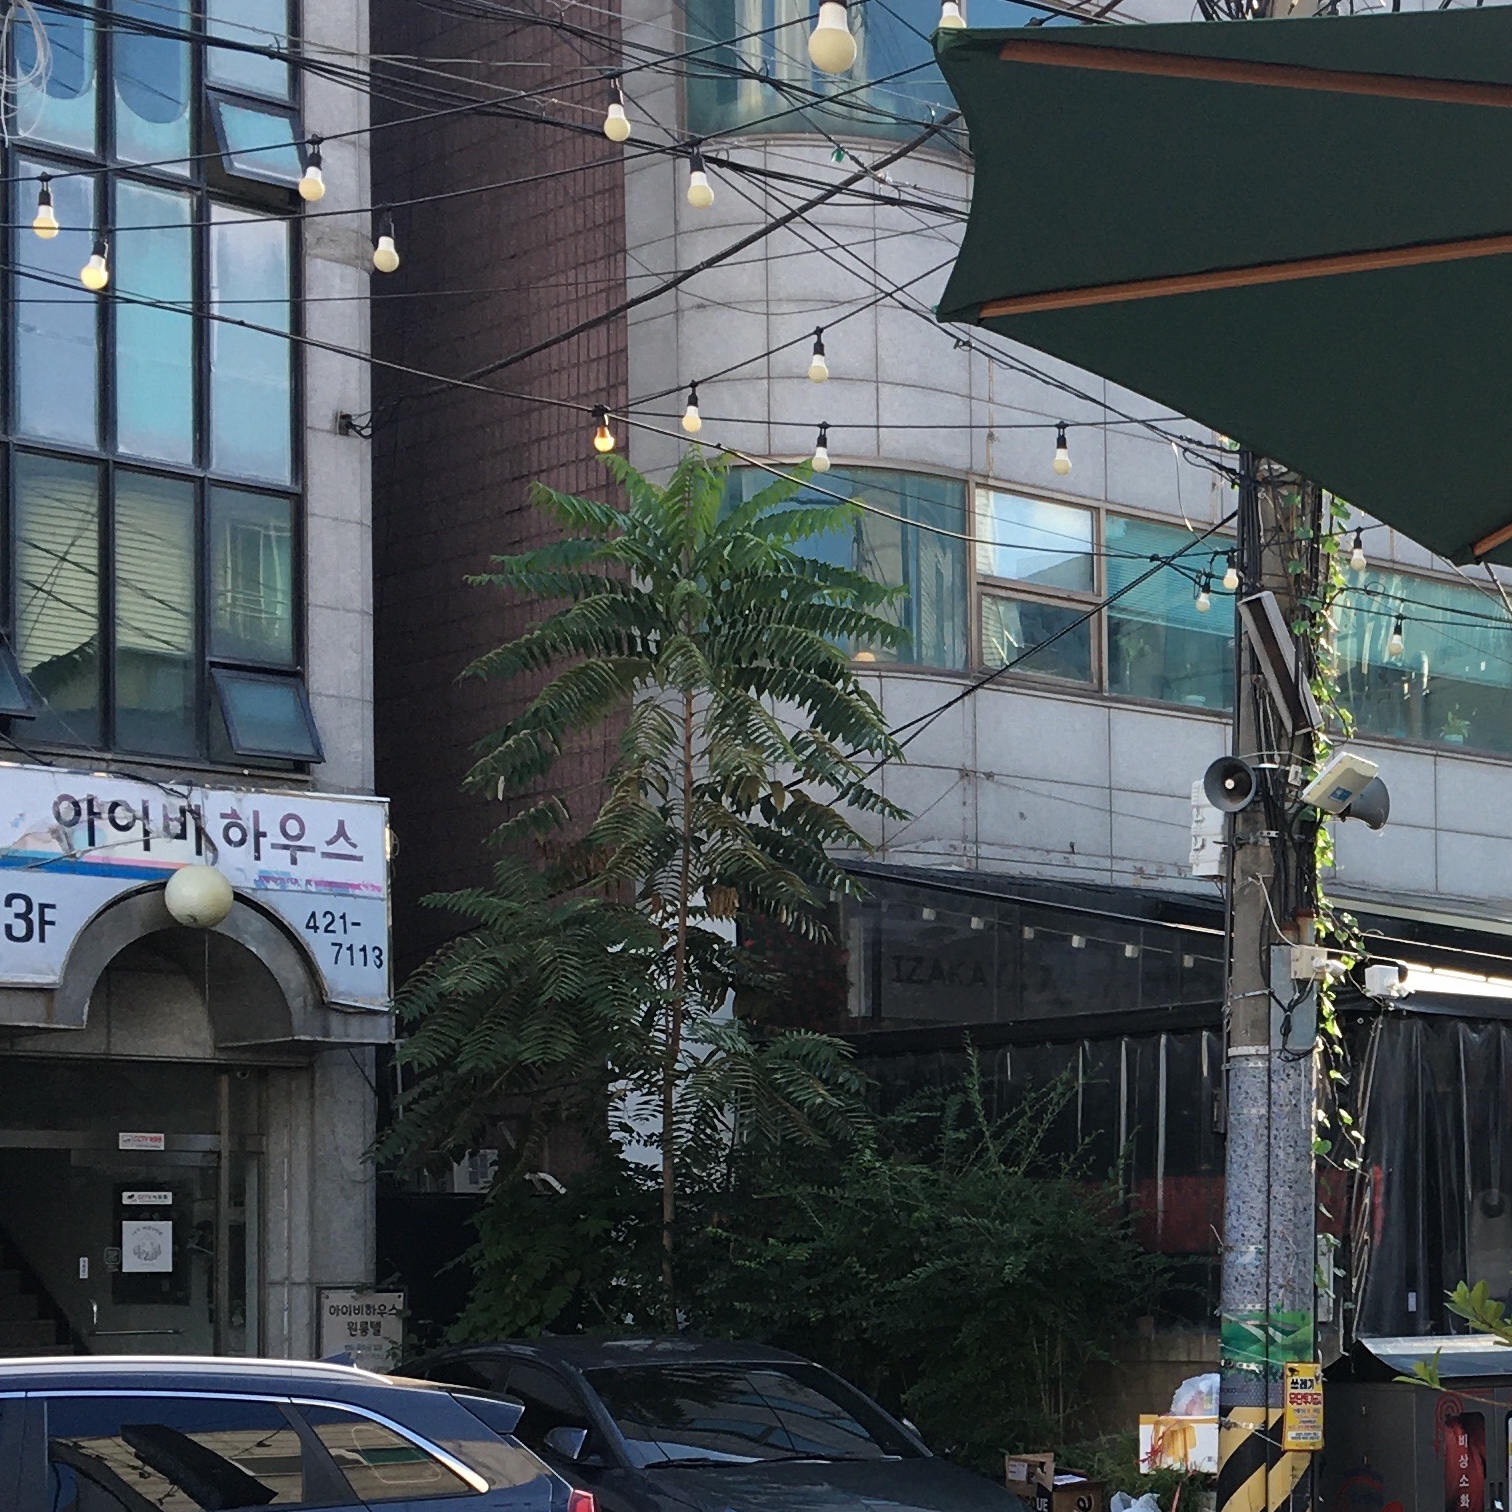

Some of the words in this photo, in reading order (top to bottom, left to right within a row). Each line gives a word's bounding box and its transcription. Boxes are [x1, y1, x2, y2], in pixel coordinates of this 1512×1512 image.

[4, 892, 57, 944] 3F
[305, 910, 362, 935] 421-
[331, 942, 384, 970] 7113
[328, 1303, 399, 1318] 아이비하우스
